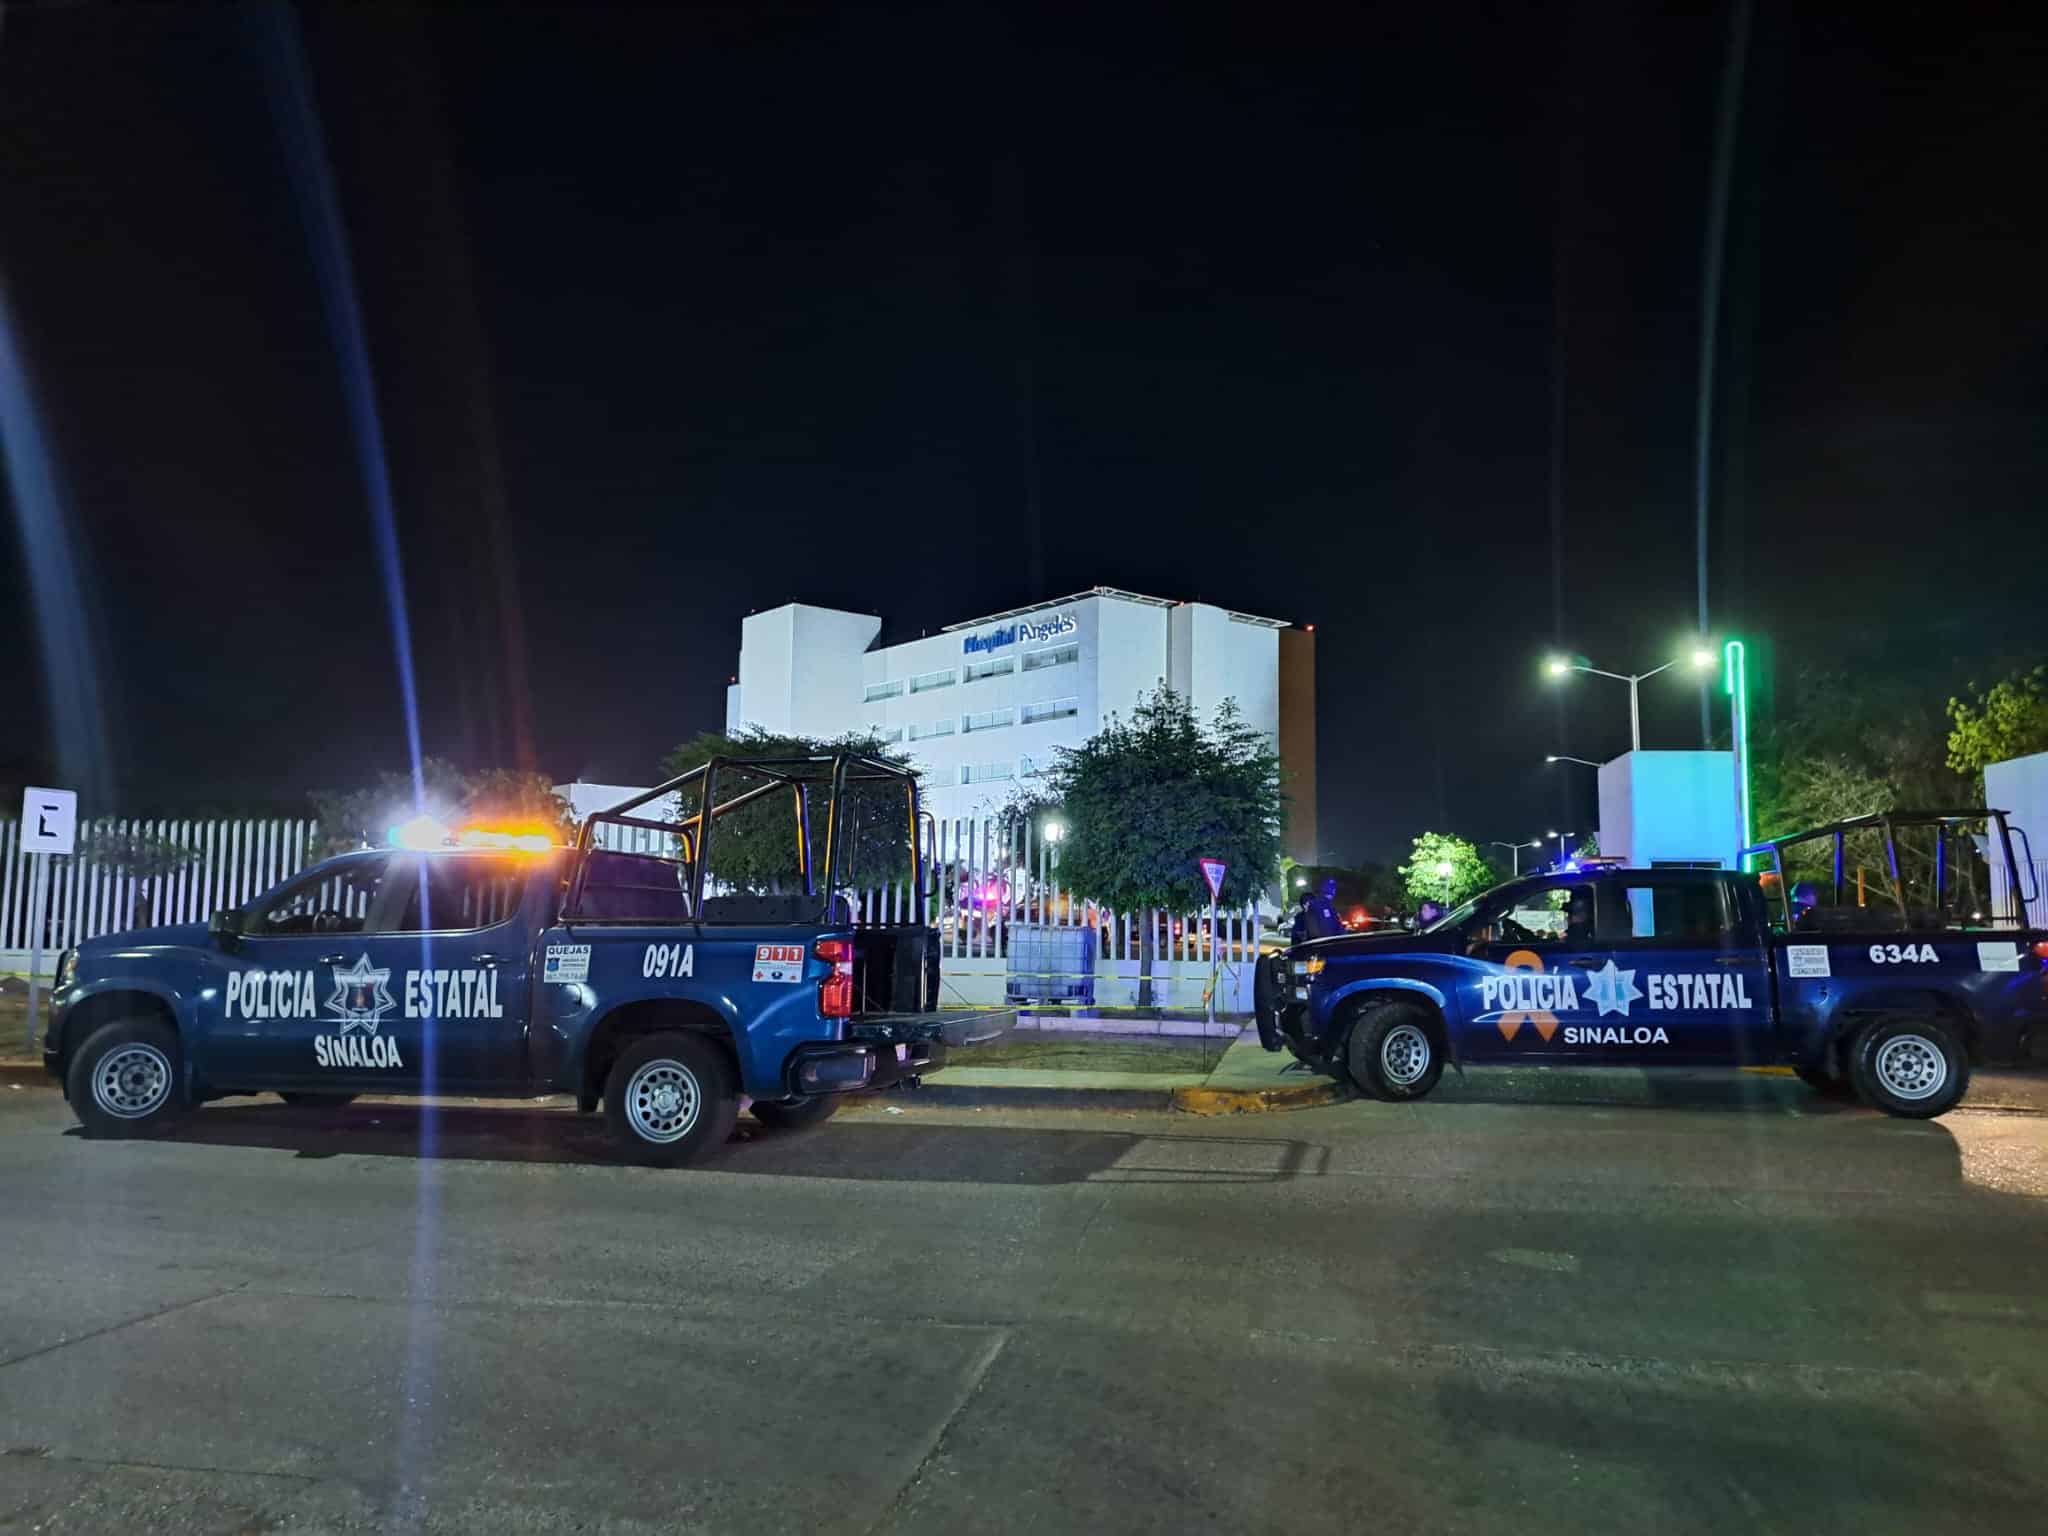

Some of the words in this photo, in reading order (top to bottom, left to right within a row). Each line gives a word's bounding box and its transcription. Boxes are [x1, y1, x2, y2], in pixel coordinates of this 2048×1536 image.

[963, 623, 1015, 654] Hospital
[1019, 615, 1076, 642] Angeles
[549, 946, 589, 954] QUEJAS
[643, 943, 694, 978] 091A
[759, 947, 799, 960] 911
[1869, 944, 1940, 963] 634A
[225, 970, 316, 1018] POLICIA
[405, 970, 504, 1018] ESTATAL
[1482, 966, 1579, 1010] POLICÍA
[1648, 973, 1753, 1009] ESTATAL
[314, 1035, 404, 1068] SINALOA
[1563, 1027, 1670, 1044] SINALOA
